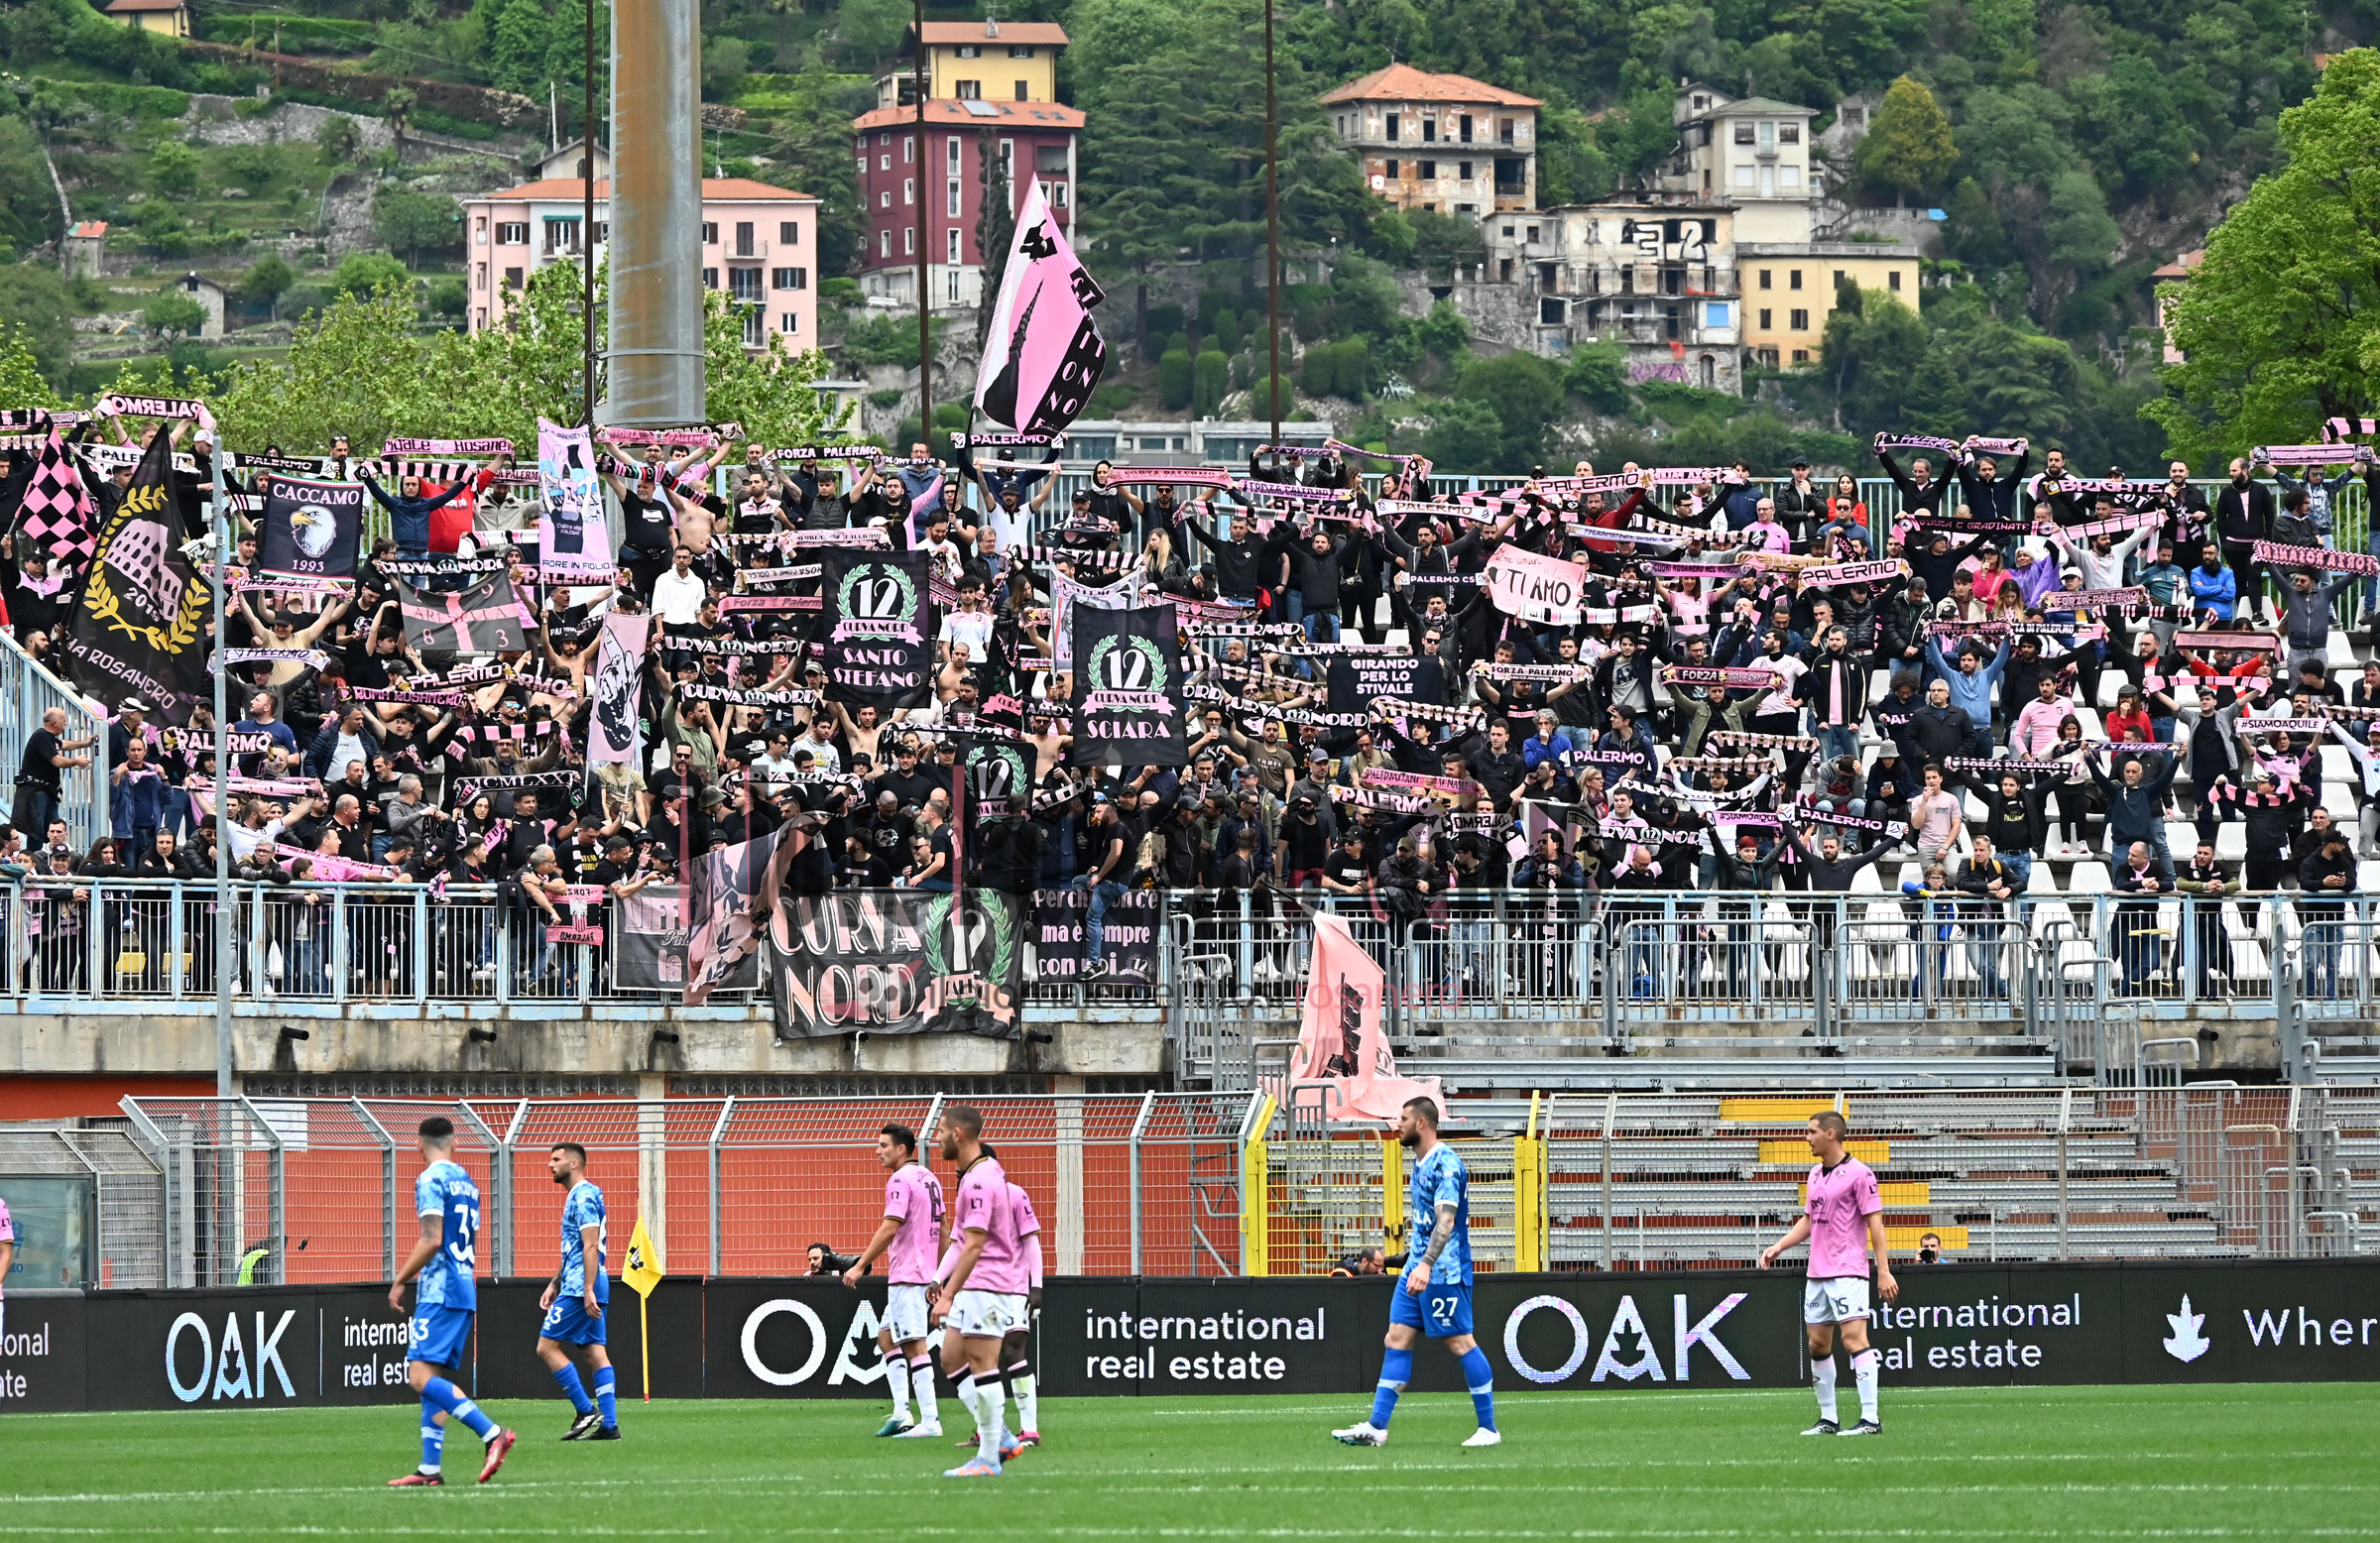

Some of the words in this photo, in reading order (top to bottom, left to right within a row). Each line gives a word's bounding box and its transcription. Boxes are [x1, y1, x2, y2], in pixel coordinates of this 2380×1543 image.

[384, 438, 431, 457] rigate
[971, 434, 1048, 445] PALERMO
[776, 447, 816, 459] FORZA
[823, 445, 878, 458] PALERMO
[245, 455, 312, 471] PALERMO
[1539, 473, 1639, 494] PALERMO
[2059, 481, 2163, 494] BRIGATE
[273, 483, 360, 505] CACCAMO
[1396, 501, 1473, 517] PALERMO
[1966, 522, 2030, 531] GRADINATE
[292, 559, 325, 572] 1993
[1803, 560, 1897, 581] PALERMO
[1411, 575, 1460, 584] PALERMO
[856, 577, 897, 619] 12
[1529, 576, 1572, 609] AMO
[2055, 595, 2088, 606] FORZA
[733, 597, 766, 608] Forza
[781, 596, 823, 609] Palerm
[843, 621, 876, 633] CURVA
[877, 621, 909, 633] NORD
[2036, 624, 2075, 635] PALERMO
[422, 628, 435, 646] 8
[495, 629, 510, 648] 3
[744, 641, 798, 654] NORD
[843, 648, 908, 666] SANTO
[1106, 648, 1148, 690] 12
[1350, 658, 1420, 670] GIRANDO
[1490, 665, 1524, 676] FORZA
[1528, 667, 1574, 677] PALERMO
[87, 650, 178, 711] ROSANERO
[407, 663, 504, 690] PALERMO
[832, 667, 922, 689] STEFANO
[1360, 670, 1388, 682] PER
[1391, 670, 1410, 682] LO
[1682, 669, 1719, 681] FORZA
[767, 689, 815, 705] NORD
[1182, 683, 1223, 700] ORD
[1356, 682, 1414, 694] STIVALE
[1094, 691, 1127, 705] CURVA
[1128, 691, 1161, 705] NORD
[1309, 712, 1368, 727] NORD
[2241, 719, 2320, 729] #SIAMOAQUILE
[1086, 719, 1172, 740] SCIARA
[177, 729, 272, 753] PALRMO
[1574, 752, 1645, 766] PALERMO
[976, 759, 1012, 800] 12
[1343, 786, 1433, 813] PALERMO
[1799, 808, 1884, 830] PALERMO
[769, 893, 922, 957] CURVA
[1041, 923, 1069, 943] ma
[1072, 920, 1083, 943] è
[657, 949, 683, 983] la
[1037, 957, 1076, 976] con
[783, 962, 916, 1027] NORD
[1431, 1296, 1459, 1318] 27
[1834, 1296, 1849, 1315] 15
[1868, 1293, 2081, 1330] nternational
[343, 1316, 414, 1347] internat
[1086, 1307, 1325, 1341] international
[1503, 1292, 1751, 1383] OAK
[165, 1309, 297, 1403] OAK
[1086, 1346, 1155, 1380] real
[1169, 1350, 1286, 1380] estate
[1870, 1337, 1914, 1371] eal
[1928, 1337, 2043, 1370] estate
[343, 1360, 378, 1387] real
[383, 1362, 413, 1386] est
